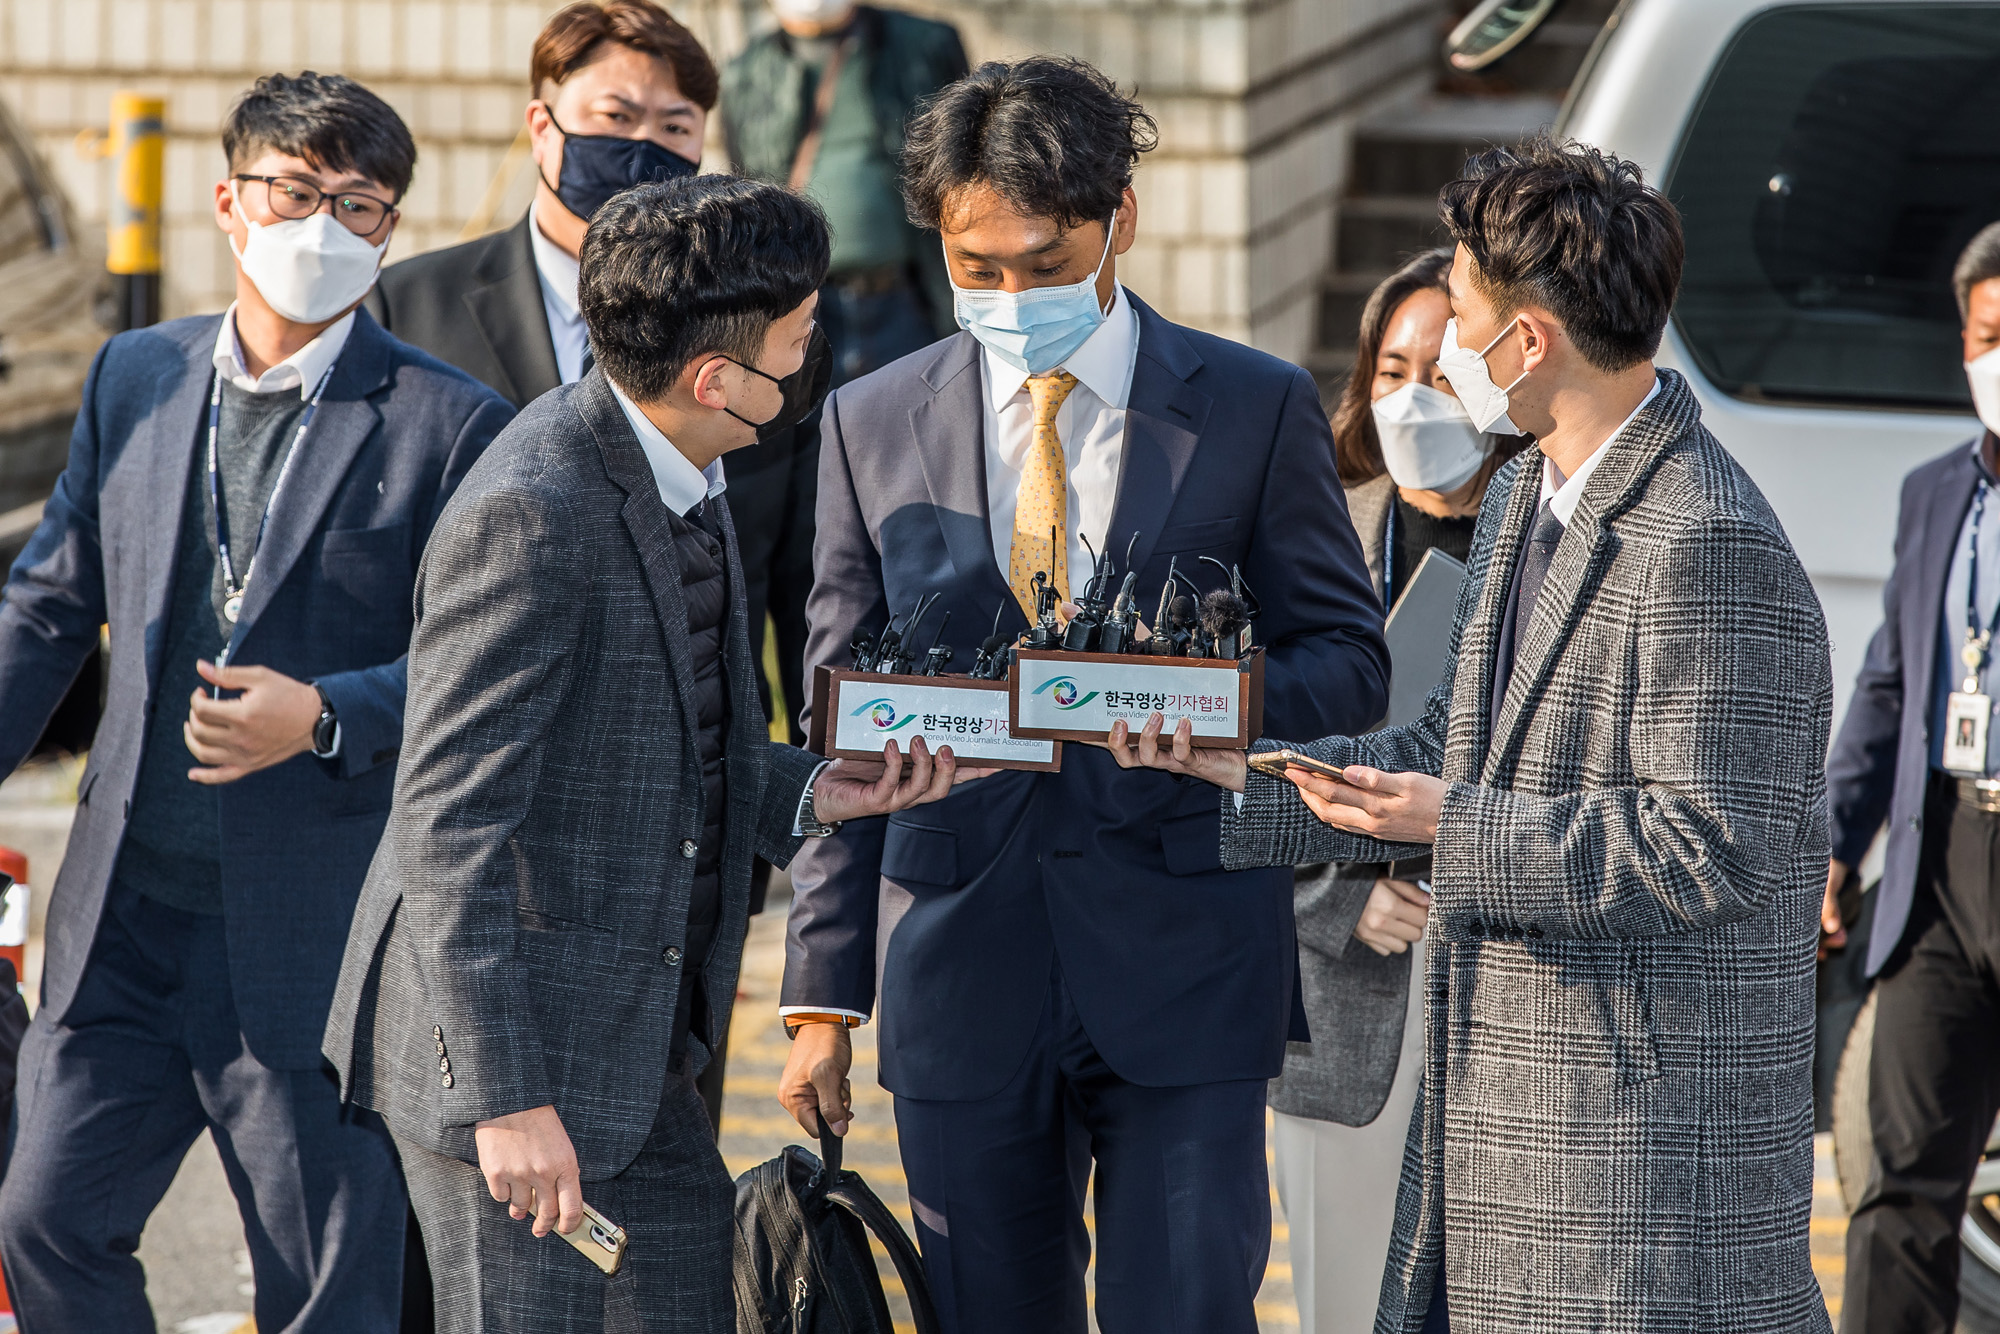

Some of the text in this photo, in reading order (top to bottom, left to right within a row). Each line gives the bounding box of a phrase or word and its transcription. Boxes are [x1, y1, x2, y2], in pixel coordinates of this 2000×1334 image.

[1105, 691, 1228, 713] 한국영상기자협회
[1106, 710, 1128, 719] Korea
[1187, 714, 1228, 723] Association
[923, 733, 1043, 748] Korea Video Journalist Association
